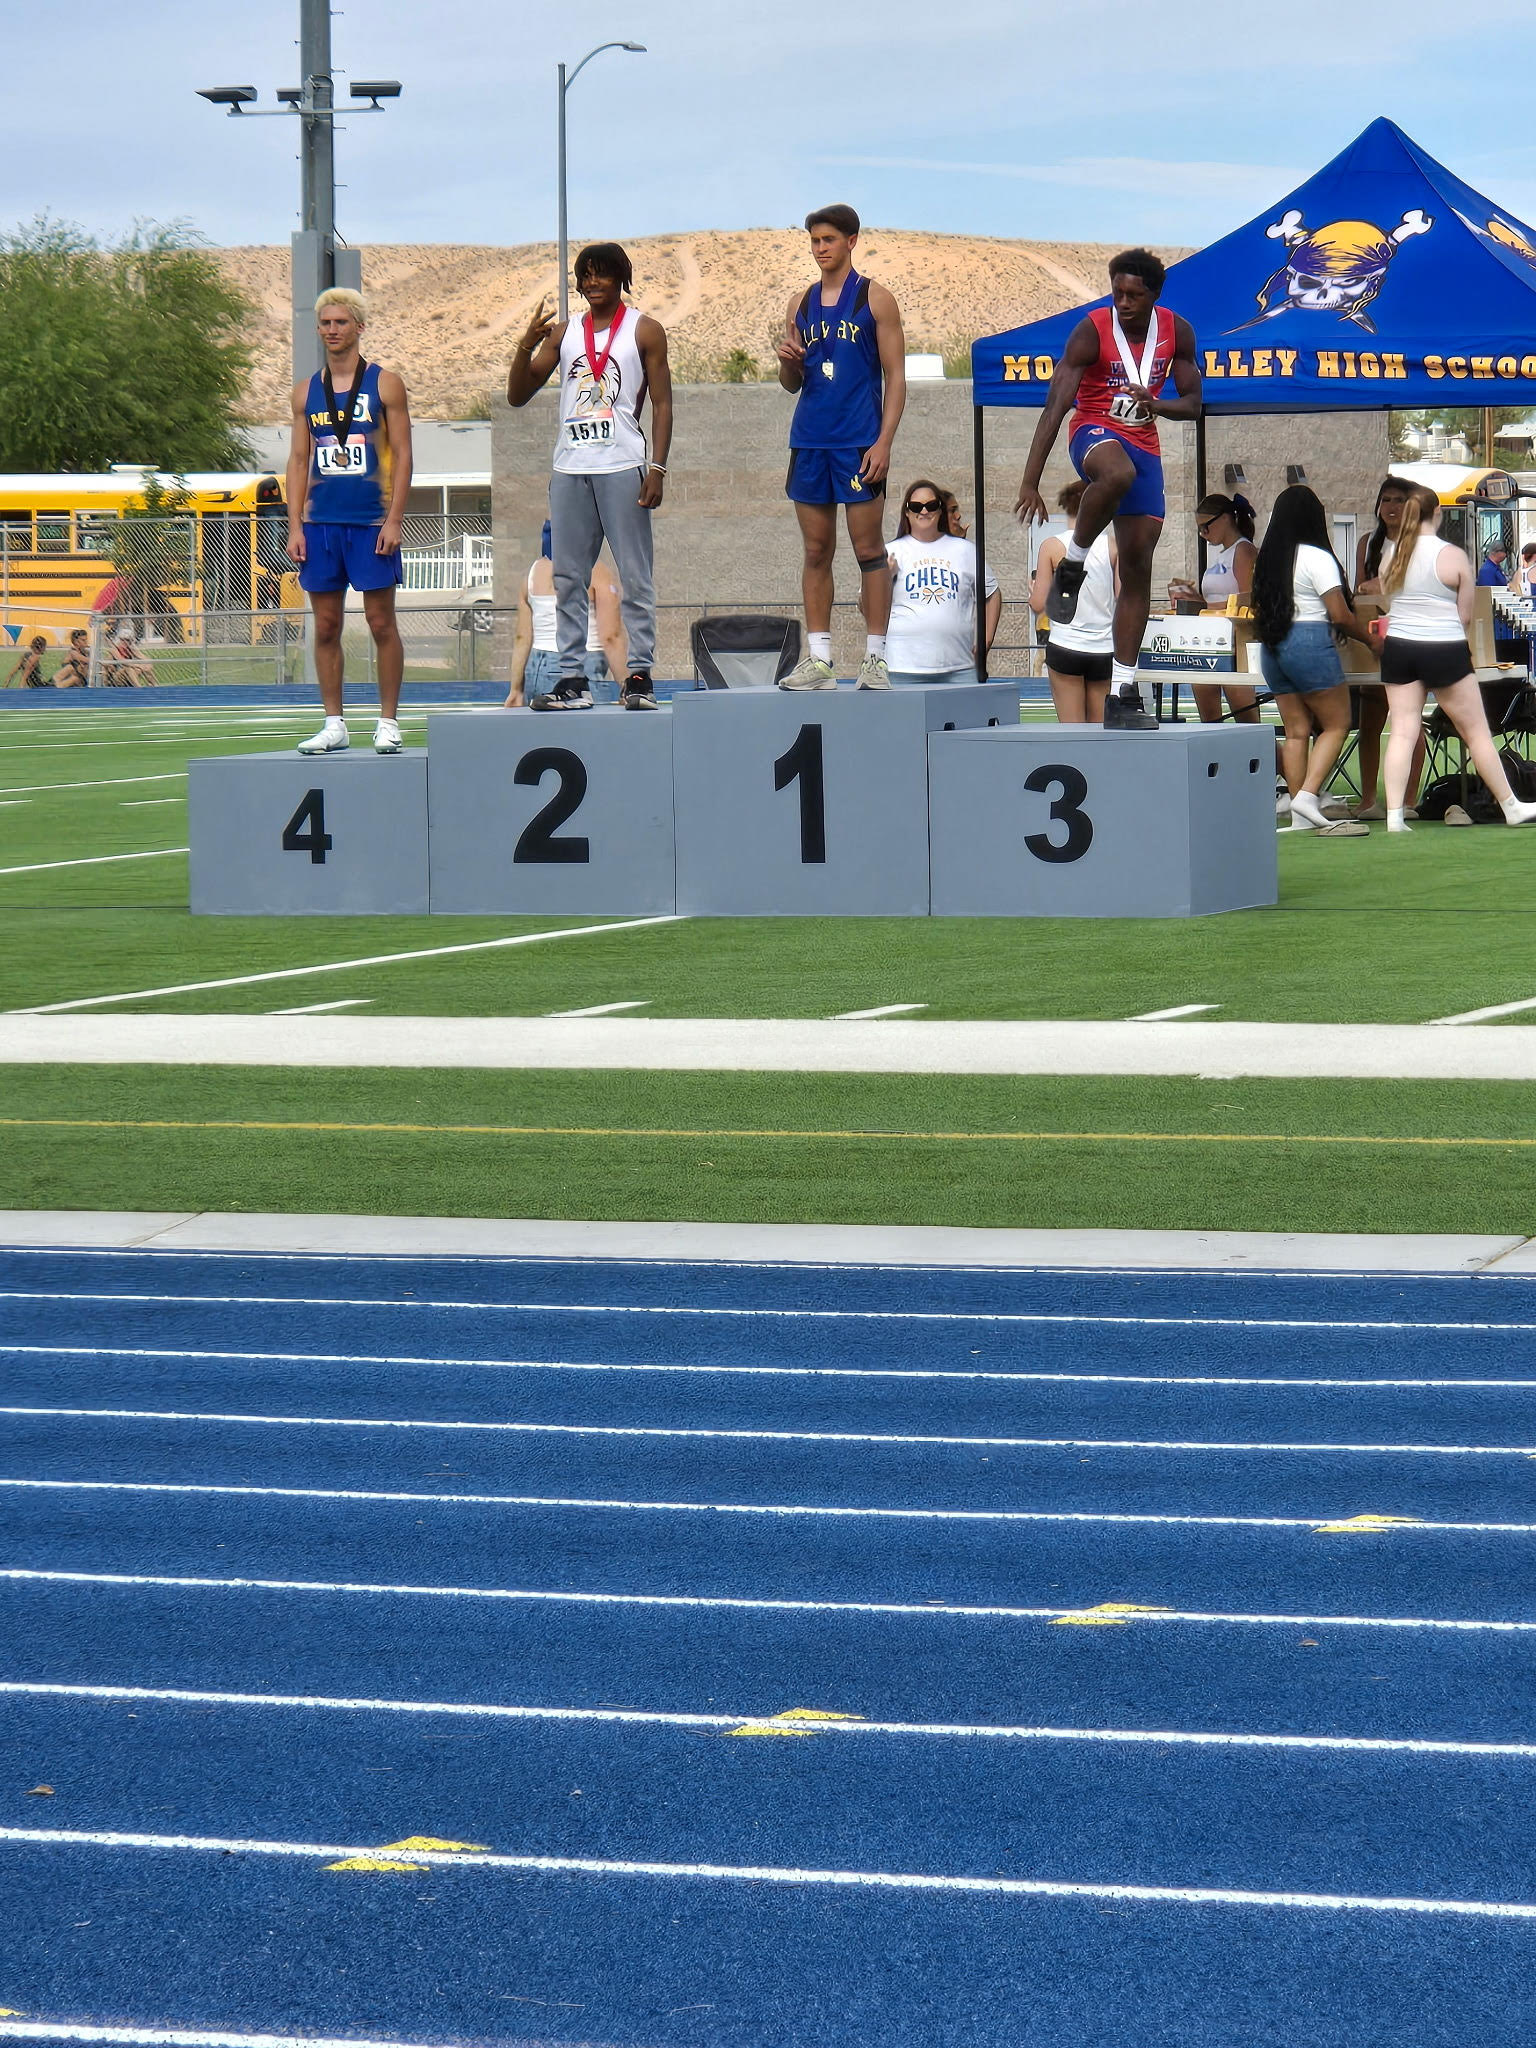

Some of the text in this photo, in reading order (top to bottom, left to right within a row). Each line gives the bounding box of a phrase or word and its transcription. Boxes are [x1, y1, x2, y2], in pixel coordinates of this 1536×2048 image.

[1003, 355, 1054, 381] MO
[1203, 349, 1298, 378] LLEY
[1316, 350, 1408, 378] HIGH
[569, 420, 610, 441] 1518
[905, 566, 959, 592] CHEER
[283, 789, 333, 865] 4
[514, 747, 590, 864] 2
[775, 724, 826, 864] 1
[1024, 765, 1094, 864] 3
